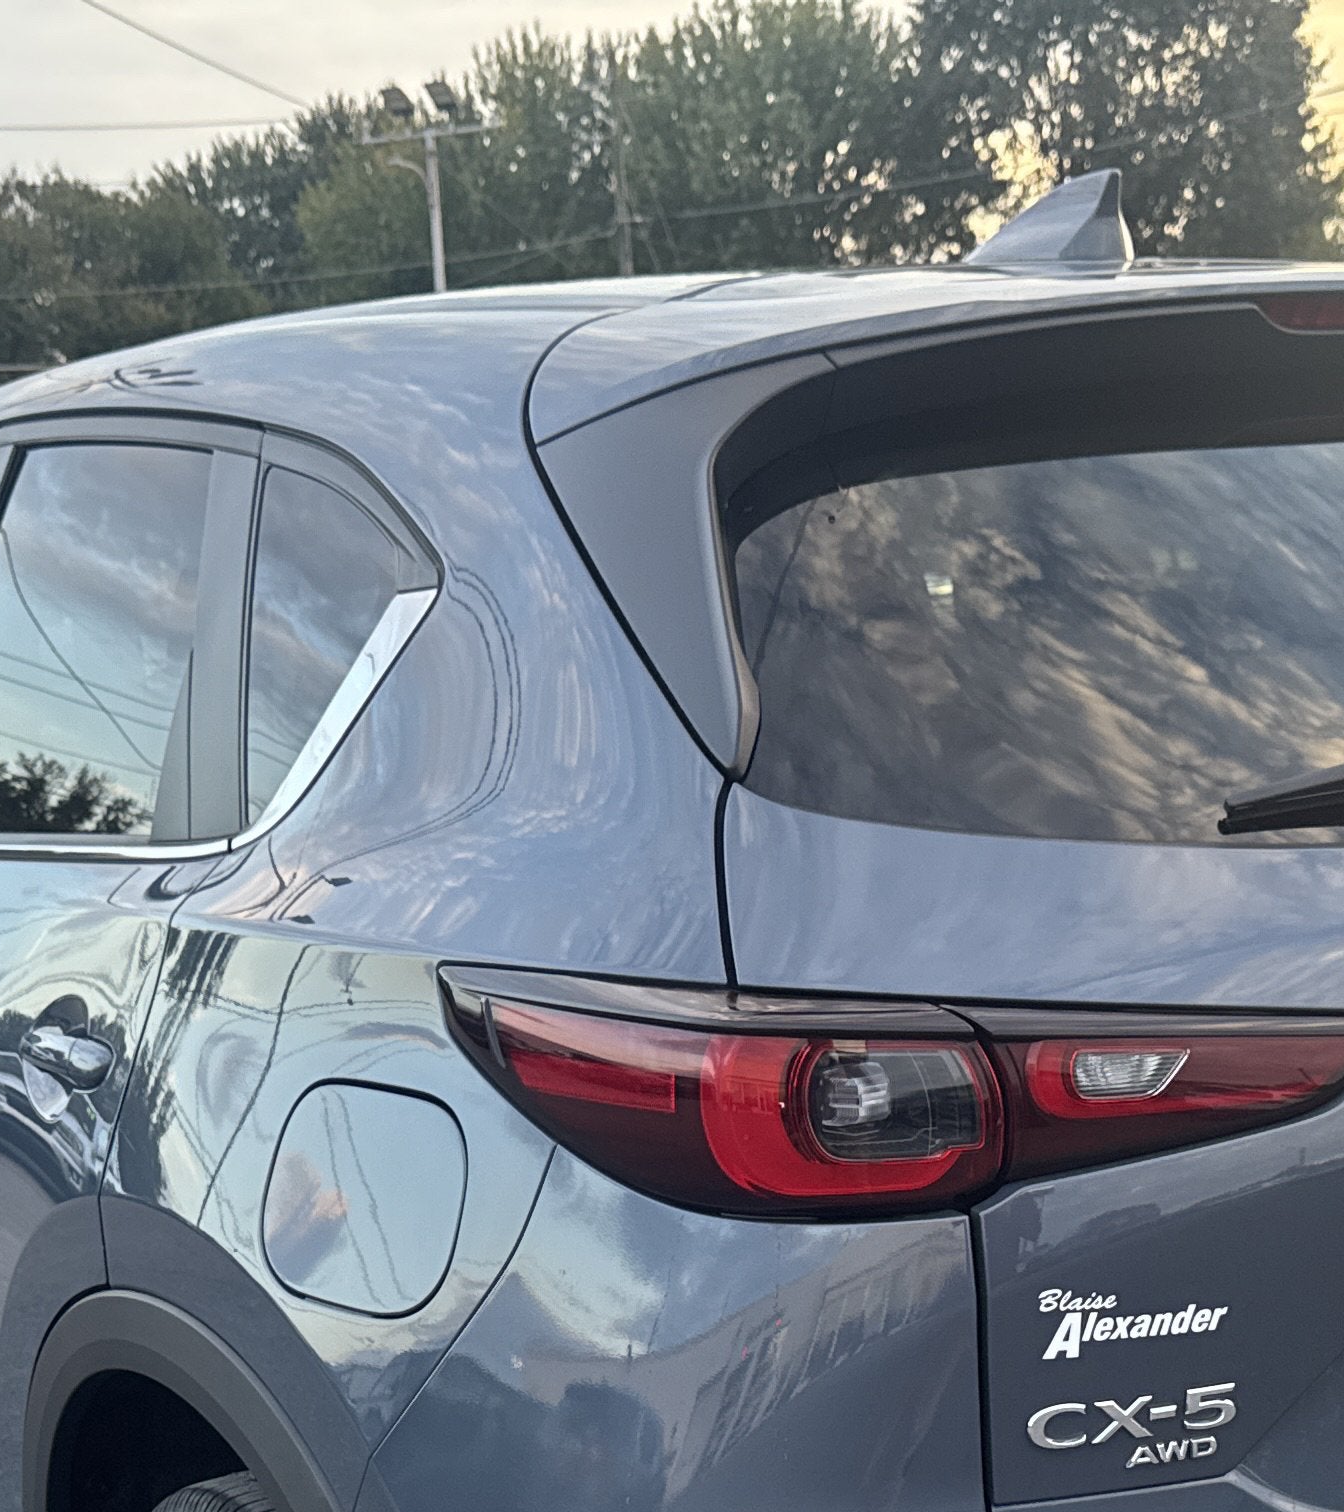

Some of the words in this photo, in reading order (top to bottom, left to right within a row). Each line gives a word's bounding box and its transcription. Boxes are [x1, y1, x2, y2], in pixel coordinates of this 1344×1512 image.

[1038, 1288, 1118, 1312] Blaise
[1042, 1303, 1229, 1360] Alexander
[1027, 1382, 1237, 1449] CX-5
[1125, 1436, 1218, 1469] AWD
